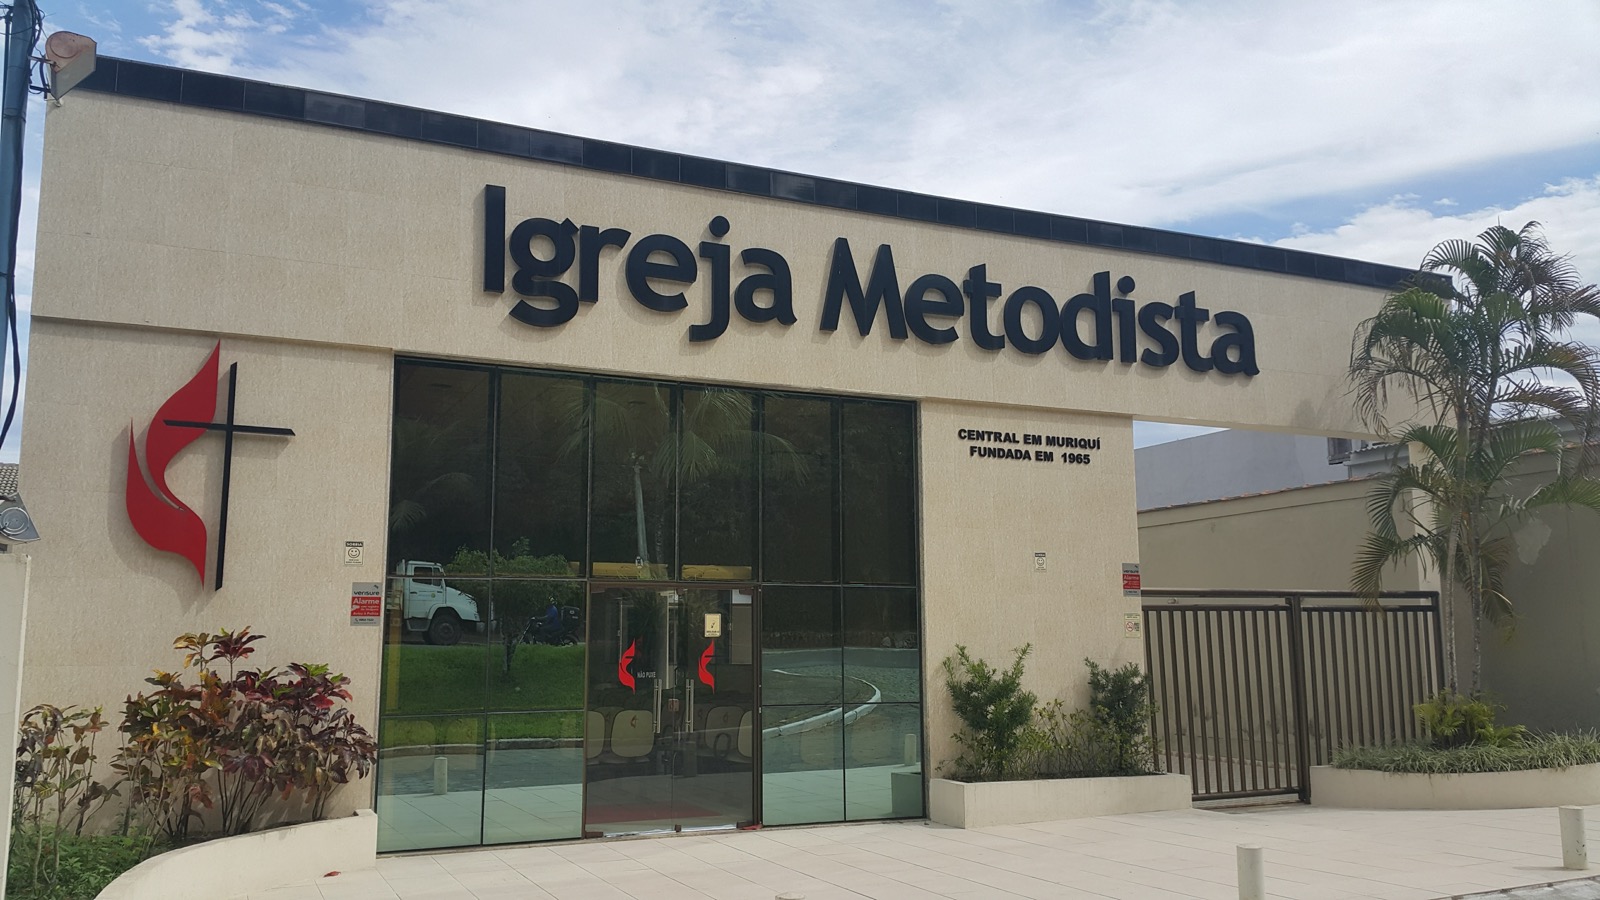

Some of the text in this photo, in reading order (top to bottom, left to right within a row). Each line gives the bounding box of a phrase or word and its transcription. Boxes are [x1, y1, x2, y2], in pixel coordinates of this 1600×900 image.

[484, 184, 1261, 377] Igreja Metodista
[957, 428, 1101, 450] CENTRAL EM MURIQUÍ
[969, 445, 1091, 465] FUNDADA EM 1965
[353, 597, 380, 605] Alarme
